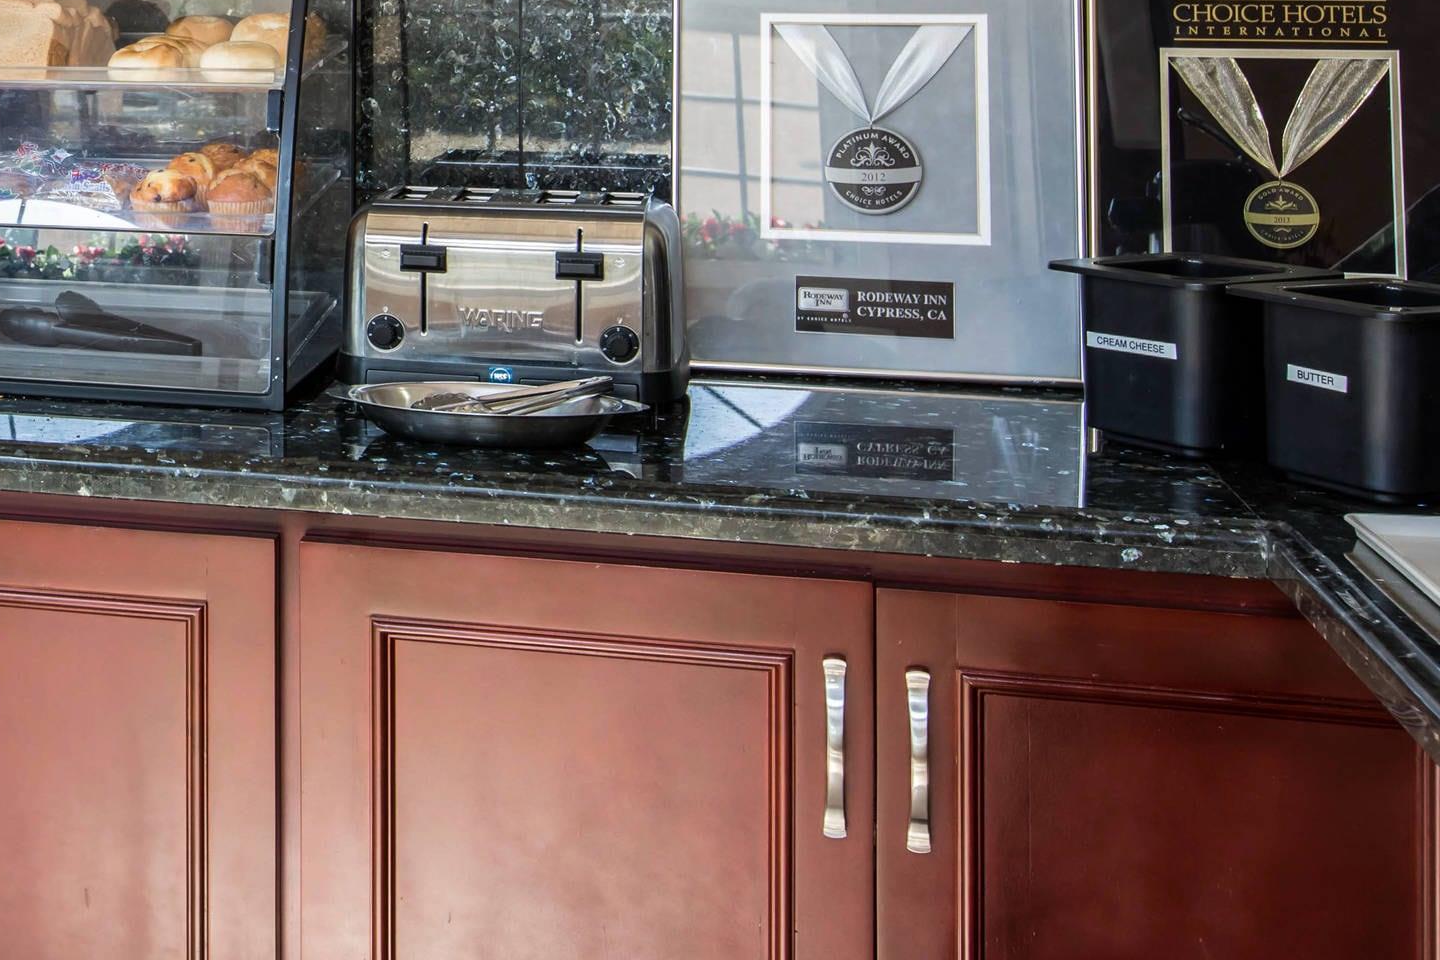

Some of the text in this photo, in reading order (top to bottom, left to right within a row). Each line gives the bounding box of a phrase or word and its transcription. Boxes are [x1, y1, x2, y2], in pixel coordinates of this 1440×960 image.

[1173, 3, 1388, 25] CHOICE HOTELS
[1175, 25, 1386, 38] INTERNATIONAL
[836, 133, 910, 159] PLATINUM AWARD
[861, 173, 886, 182] 2012
[846, 190, 903, 205] CHOICE HOTELS
[1258, 188, 1304, 200] GOLD AWARD
[803, 291, 844, 301] RODEWAY
[815, 299, 832, 307] INN
[856, 291, 947, 305] RODEWAY INN
[457, 306, 545, 332] WARING
[856, 306, 947, 321] CYPRESS, CA
[1096, 335, 1165, 354] CREAM CHEESE
[1296, 370, 1334, 386] BUTTER
